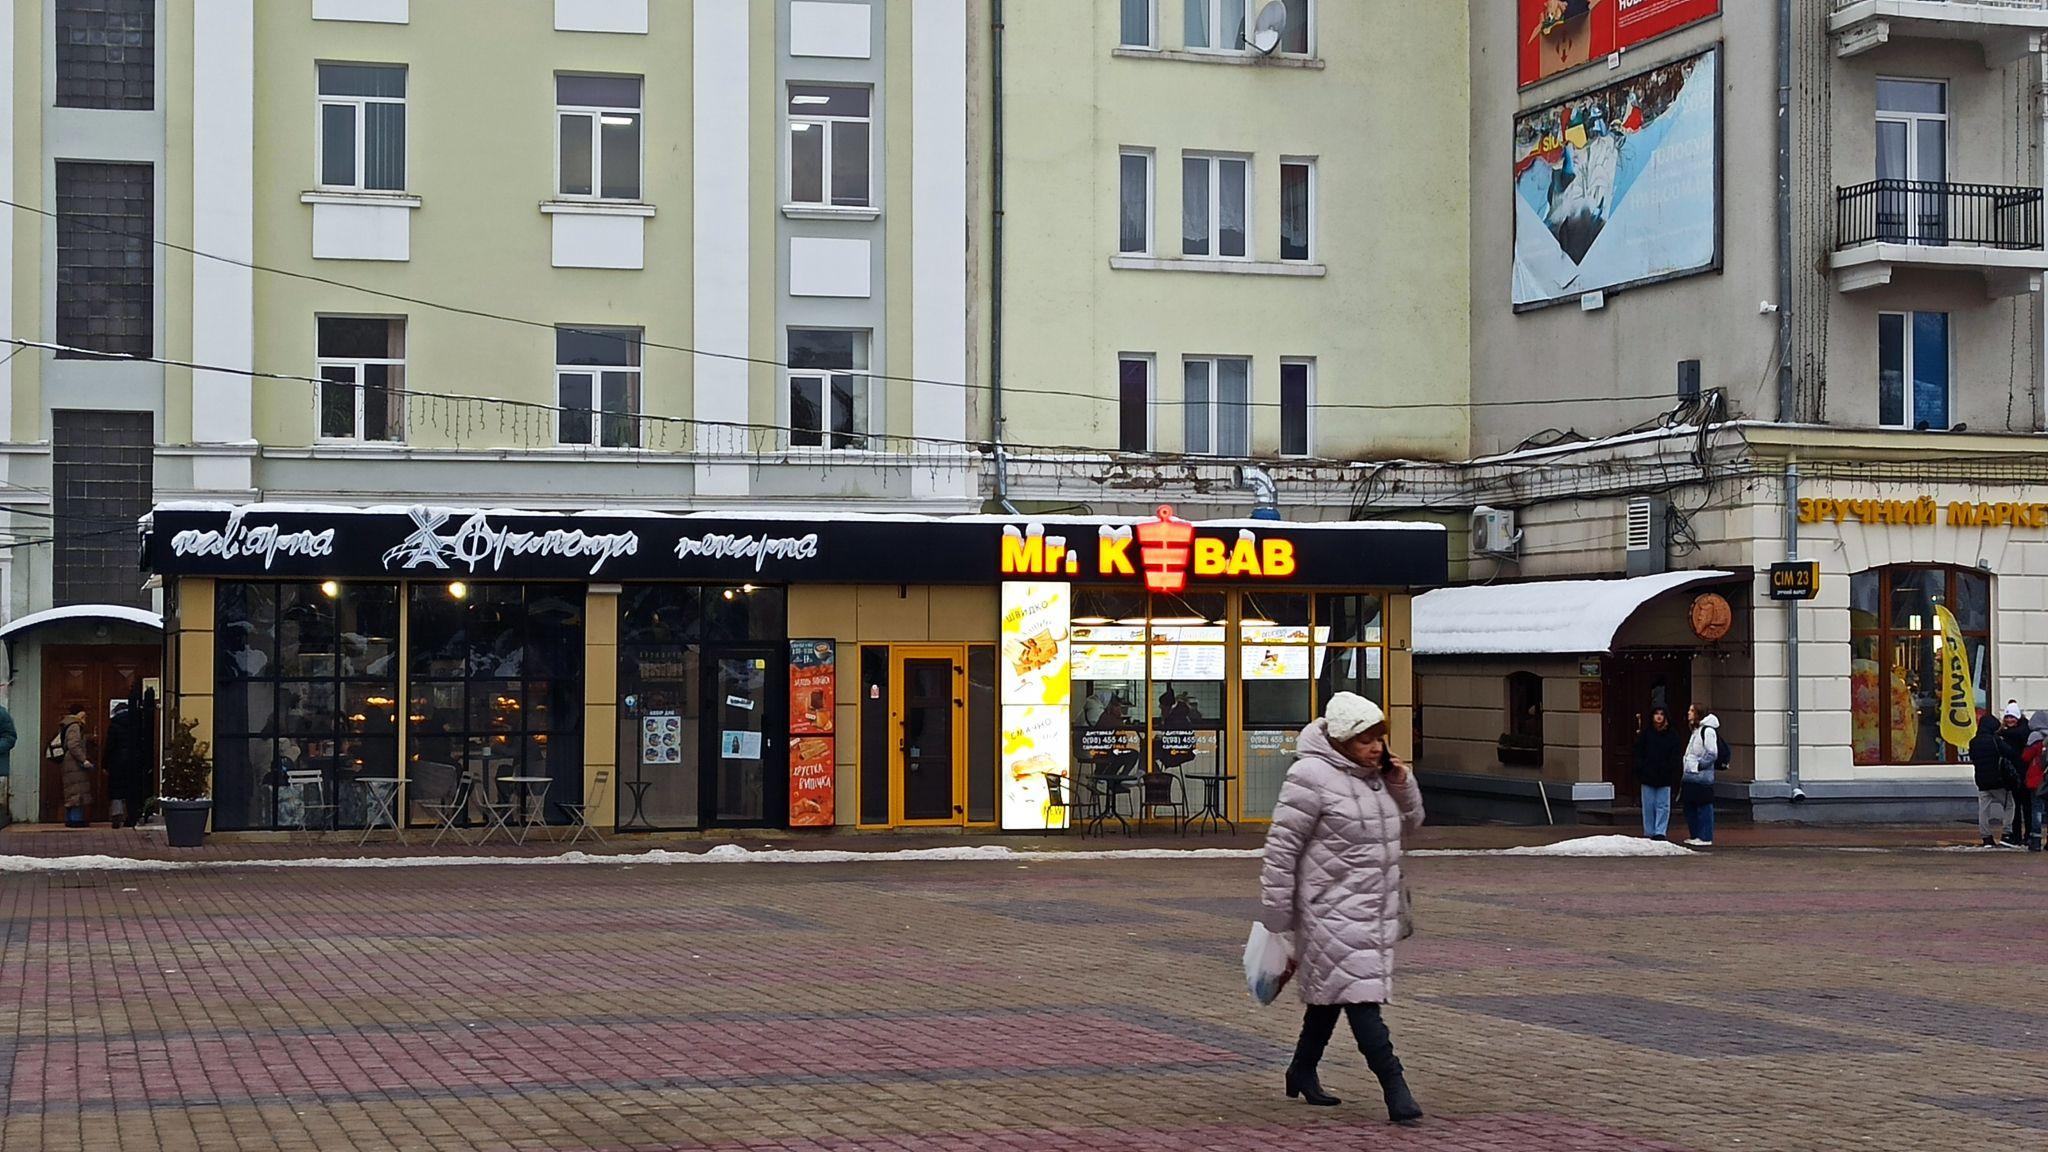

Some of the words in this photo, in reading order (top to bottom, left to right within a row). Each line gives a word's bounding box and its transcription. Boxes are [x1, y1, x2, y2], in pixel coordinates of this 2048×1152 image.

[1797, 495, 1936, 525] ЗРУЧНИЙ
[1947, 501, 2048, 528] МАРКЕ
[674, 533, 818, 572] пекарня
[1001, 528, 1079, 574] Mr.
[1796, 570, 1809, 586] 23
[1006, 600, 1049, 623] ШВИДКО
